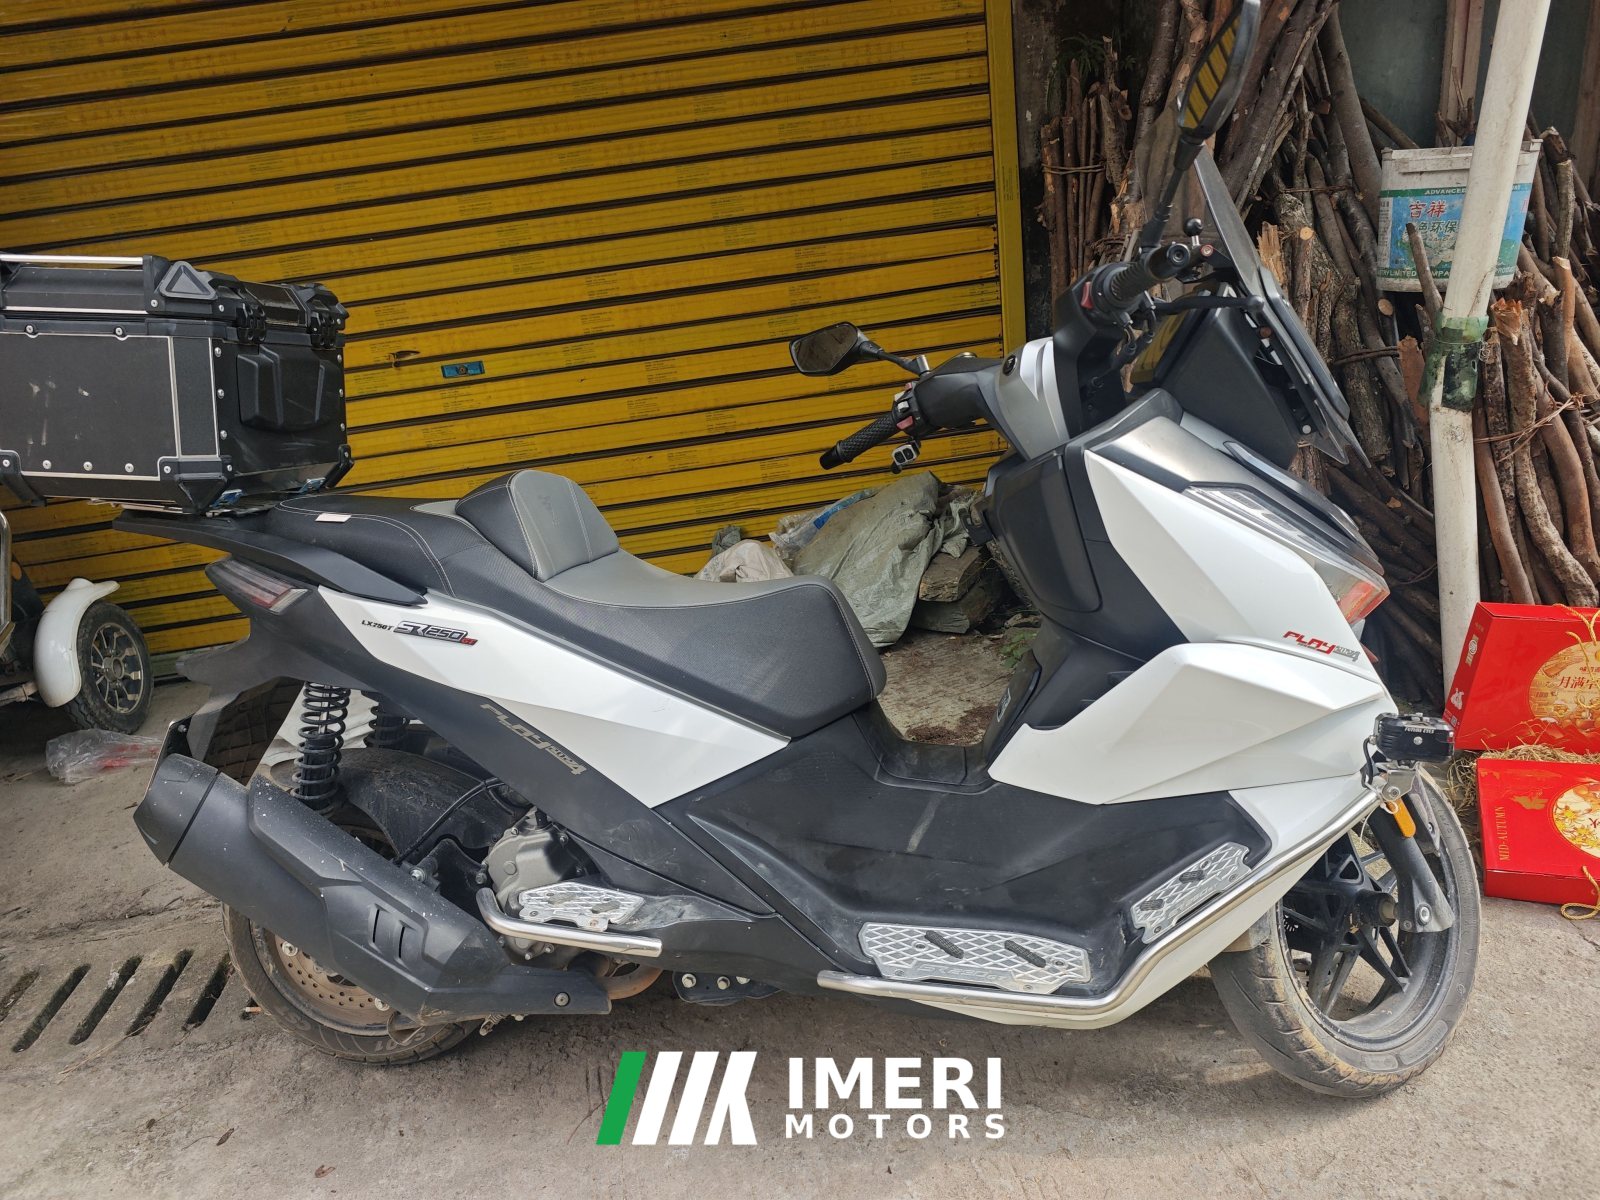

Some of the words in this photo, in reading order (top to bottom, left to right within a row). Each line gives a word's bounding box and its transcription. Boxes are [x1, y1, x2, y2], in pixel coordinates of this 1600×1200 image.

[1409, 200, 1446, 218] 吉祥
[1413, 221, 1457, 233] 色环保
[1495, 806, 1510, 861] MID-AUTUMN
